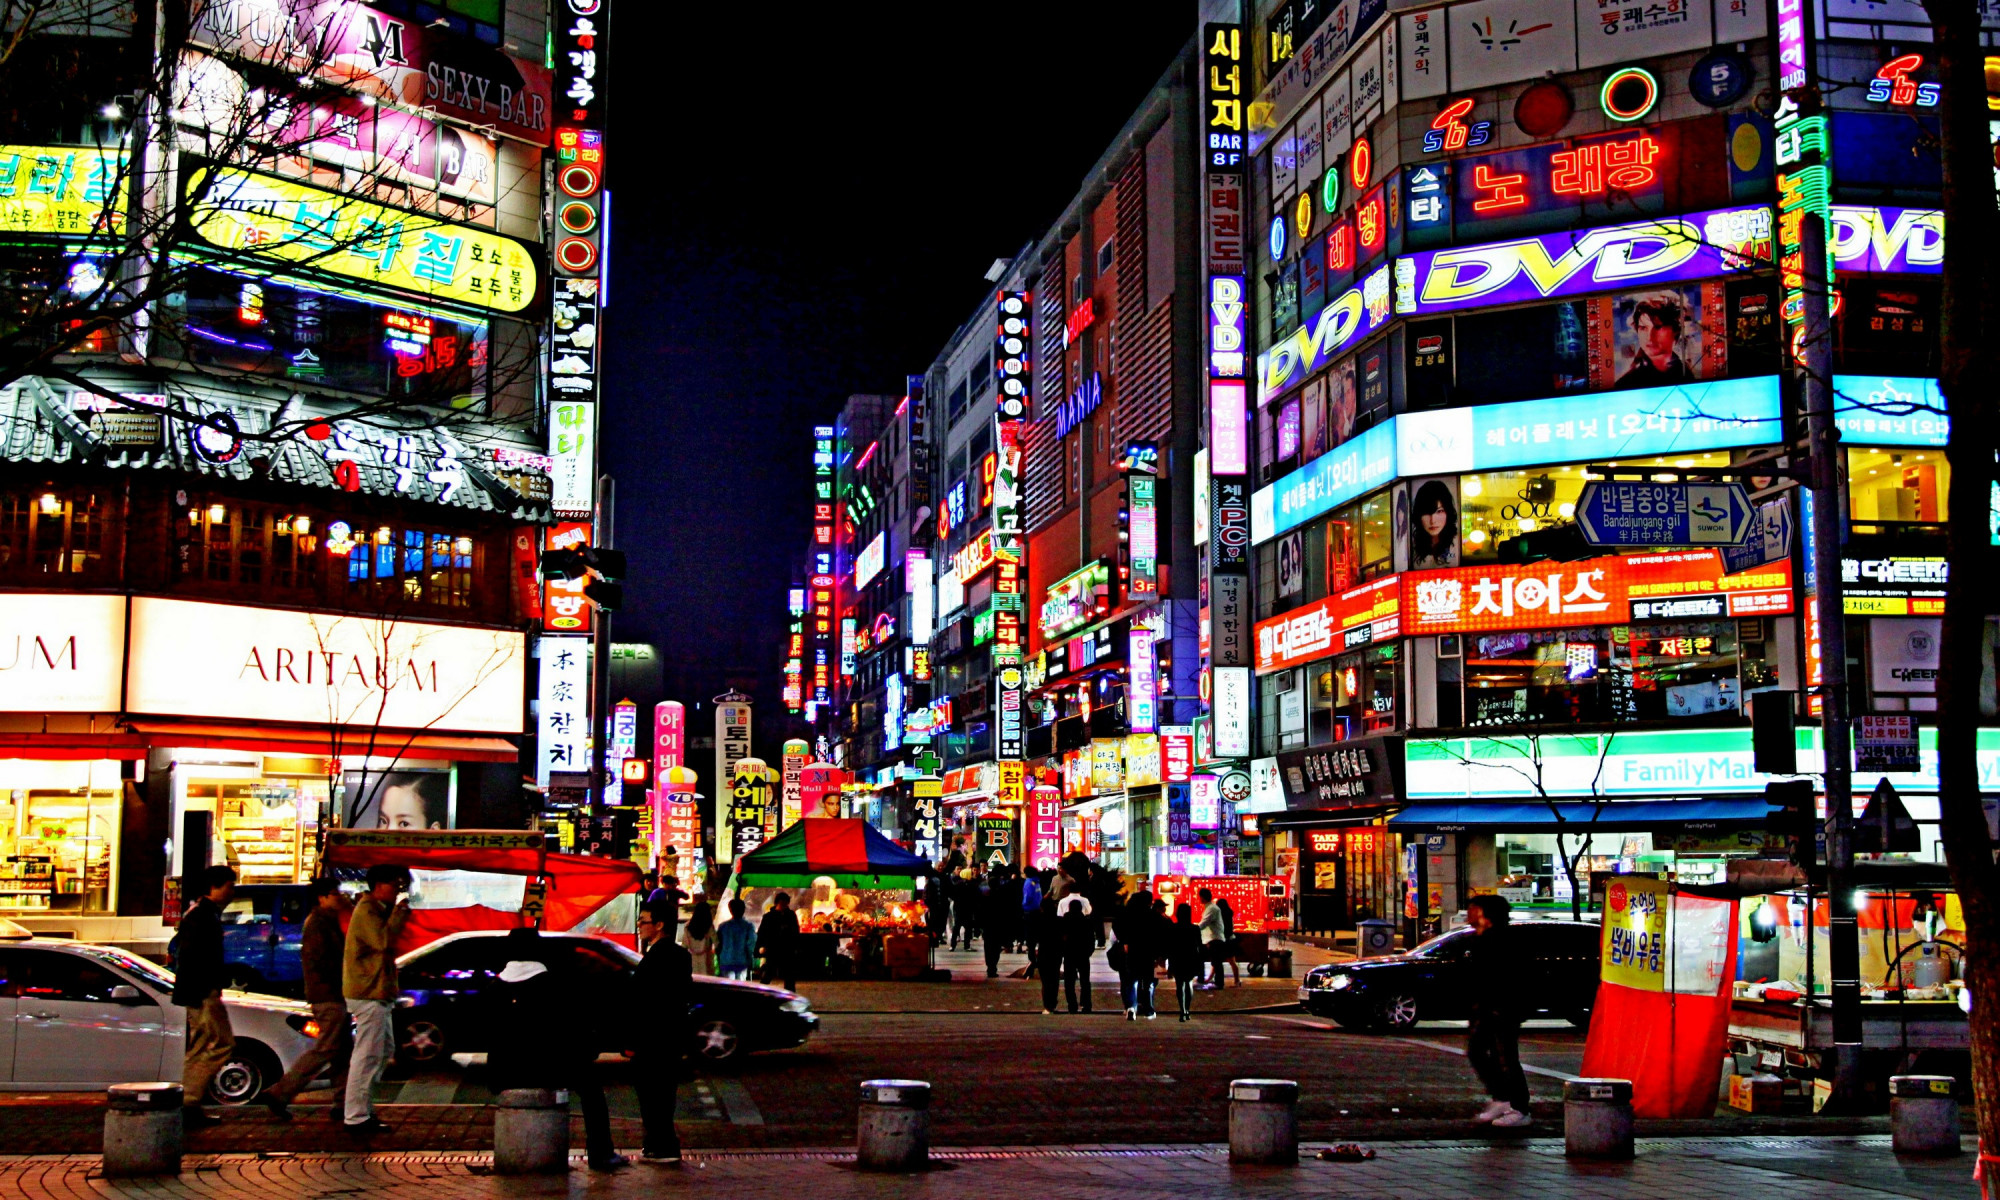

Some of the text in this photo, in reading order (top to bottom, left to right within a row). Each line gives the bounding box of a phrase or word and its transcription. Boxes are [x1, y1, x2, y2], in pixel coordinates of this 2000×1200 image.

[1209, 28, 1241, 131] 시너지
[426, 61, 545, 132] SEXY BAR
[1210, 133, 1242, 149] BAR
[1774, 96, 1802, 166] 스타
[447, 145, 489, 184] BAR
[1212, 152, 1241, 166] 8F
[1474, 137, 1660, 212] 노래방
[1411, 167, 1443, 222] 스타
[245, 227, 271, 245] 3F
[1210, 189, 1242, 261] 태권도
[1705, 207, 1771, 246] 상영관
[1420, 219, 1701, 303] DVD
[1068, 297, 1095, 345] HOTEL
[1211, 278, 1243, 351] DVD
[1266, 287, 1364, 394] DVD
[1415, 353, 1446, 367] 감상실
[1056, 371, 1101, 441] MANIA
[556, 404, 587, 457] 파티
[1486, 419, 1598, 447] 헤어플래닛
[1601, 486, 1688, 514] 반달중앙길
[1618, 531, 1674, 543] 半月中央路
[1134, 581, 1156, 593] 3F
[1221, 577, 1240, 587] 영통
[1470, 569, 1612, 617] 치어스
[1852, 601, 1885, 611] 치어스
[1222, 588, 1239, 664] 경희한의원
[239, 646, 437, 693] ARITAUM
[1001, 690, 1021, 741] WABAR
[1863, 716, 1909, 727] 횡단보도
[1162, 726, 1191, 734] 스타
[1863, 728, 1910, 739] 신호위반
[786, 745, 802, 754] 2F
[1094, 762, 1120, 773] 사격장
[1003, 771, 1021, 801] 참치
[1311, 834, 1340, 842] TAKE
[1427, 836, 1443, 845] ADT
[1436, 825, 1466, 833] FamilyMart
[591, 842, 600, 852] P
[1314, 843, 1337, 852] OUT
